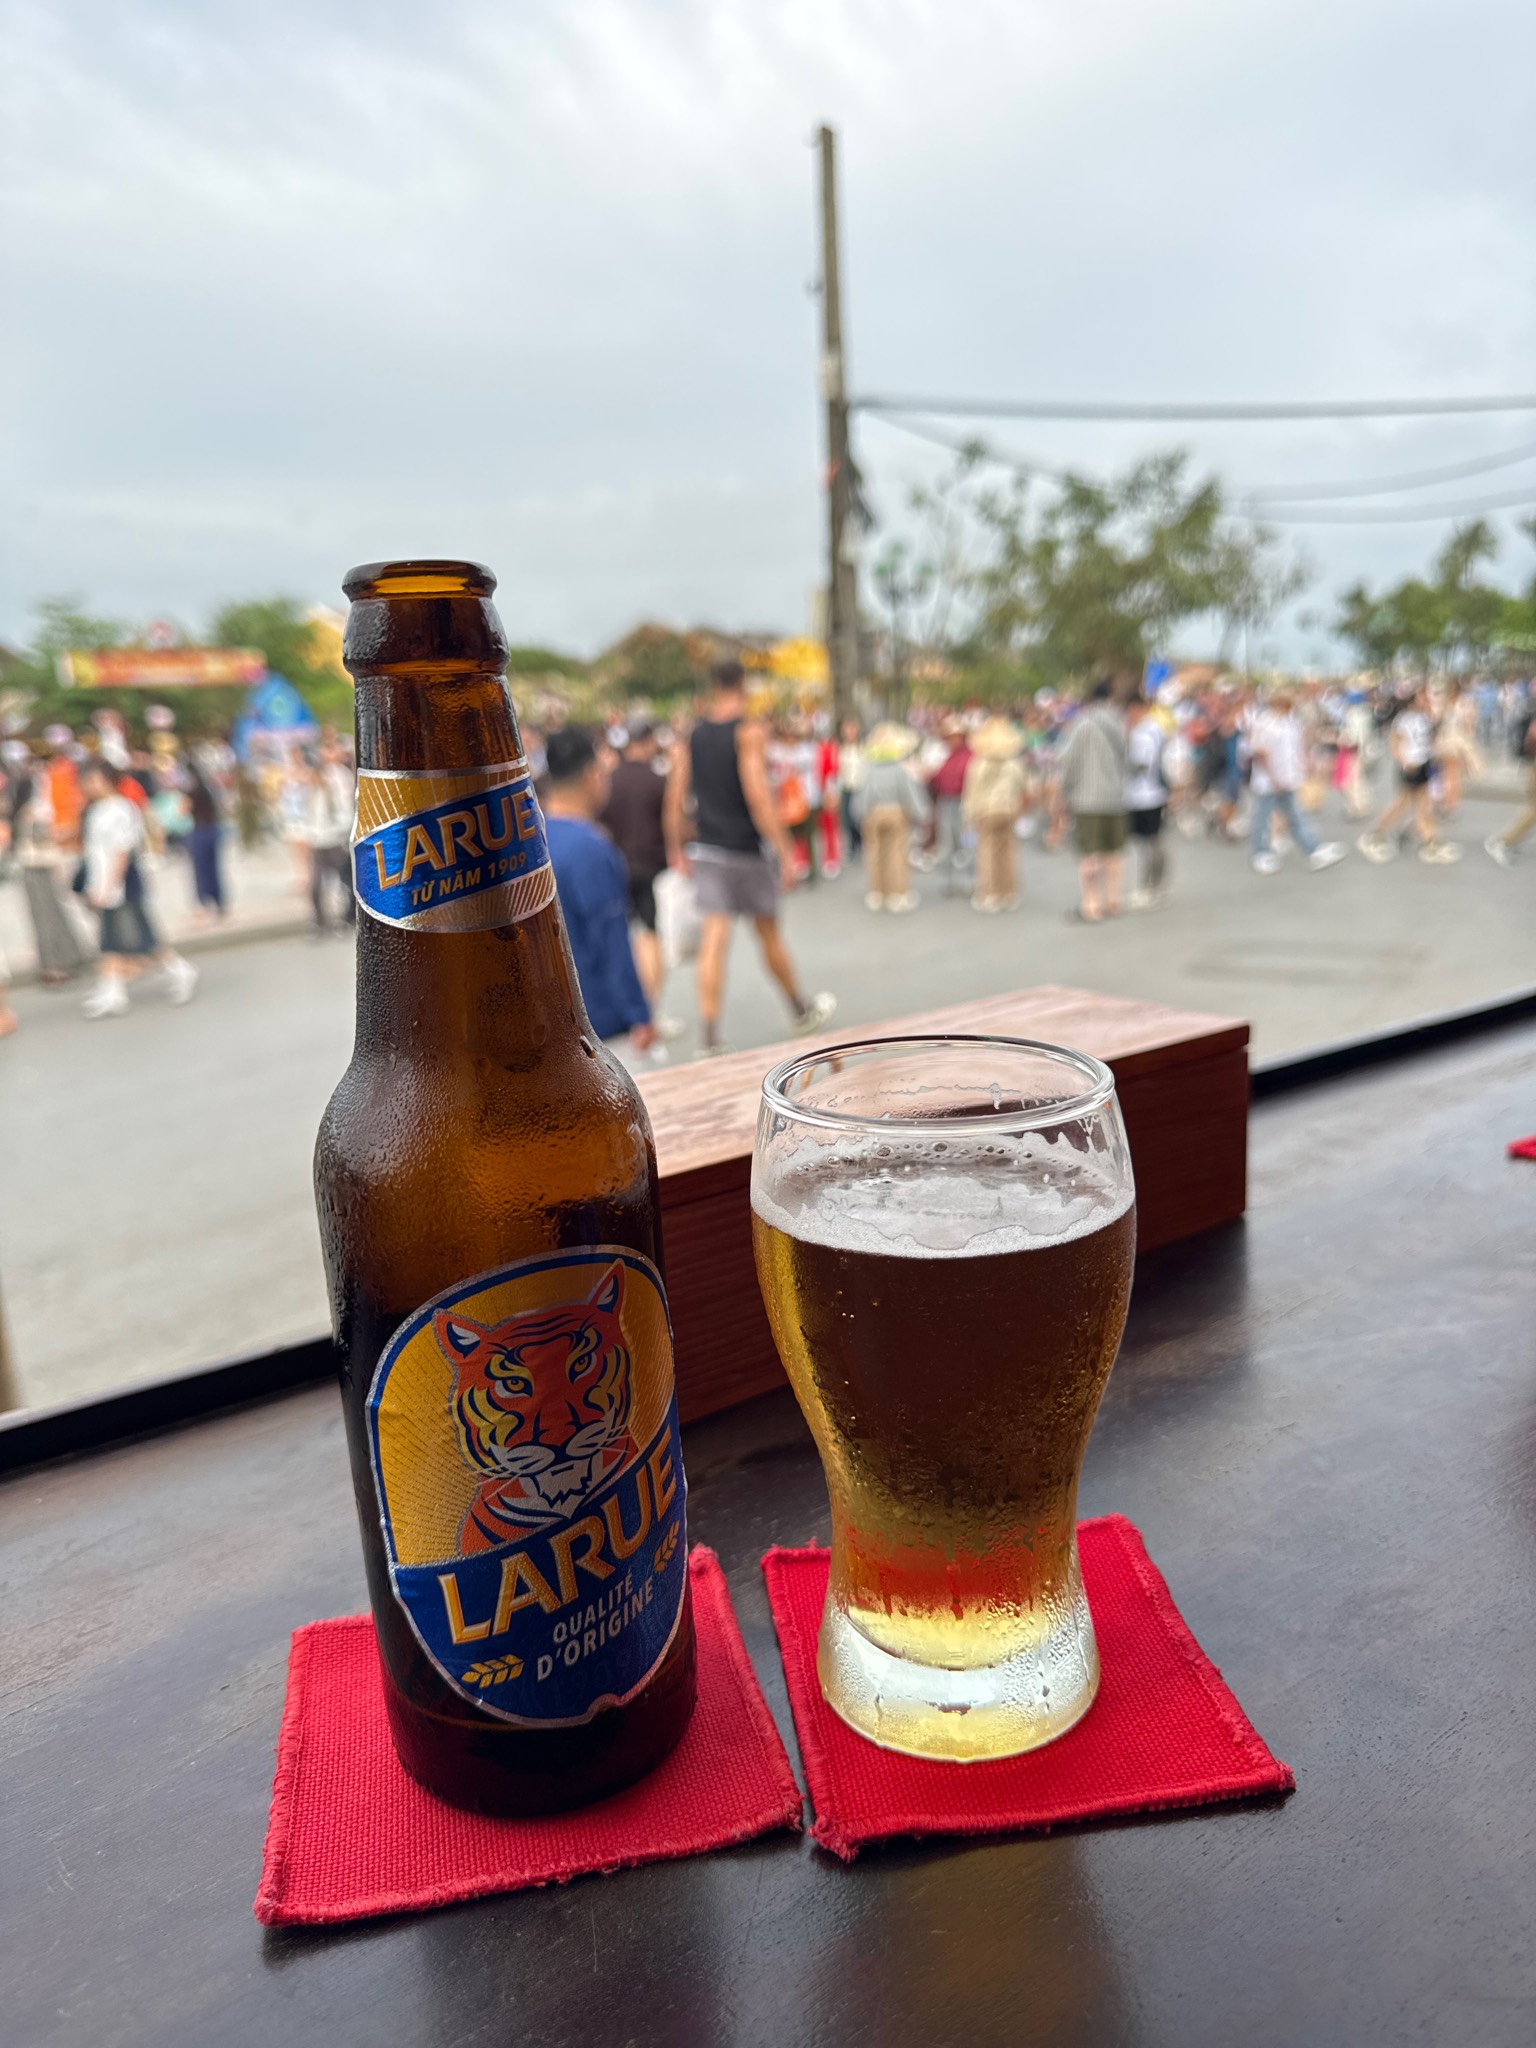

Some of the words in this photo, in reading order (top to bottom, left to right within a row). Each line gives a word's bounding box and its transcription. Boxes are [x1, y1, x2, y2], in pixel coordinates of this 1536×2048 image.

[374, 788, 536, 890] LARUE
[412, 881, 434, 905] TỪ
[439, 868, 481, 897] NĂM
[489, 853, 526, 879] 1909
[438, 1426, 676, 1645] LARUE
[537, 1577, 654, 1682] D'ORIGINE
[553, 1570, 633, 1645] QUALITÉ
